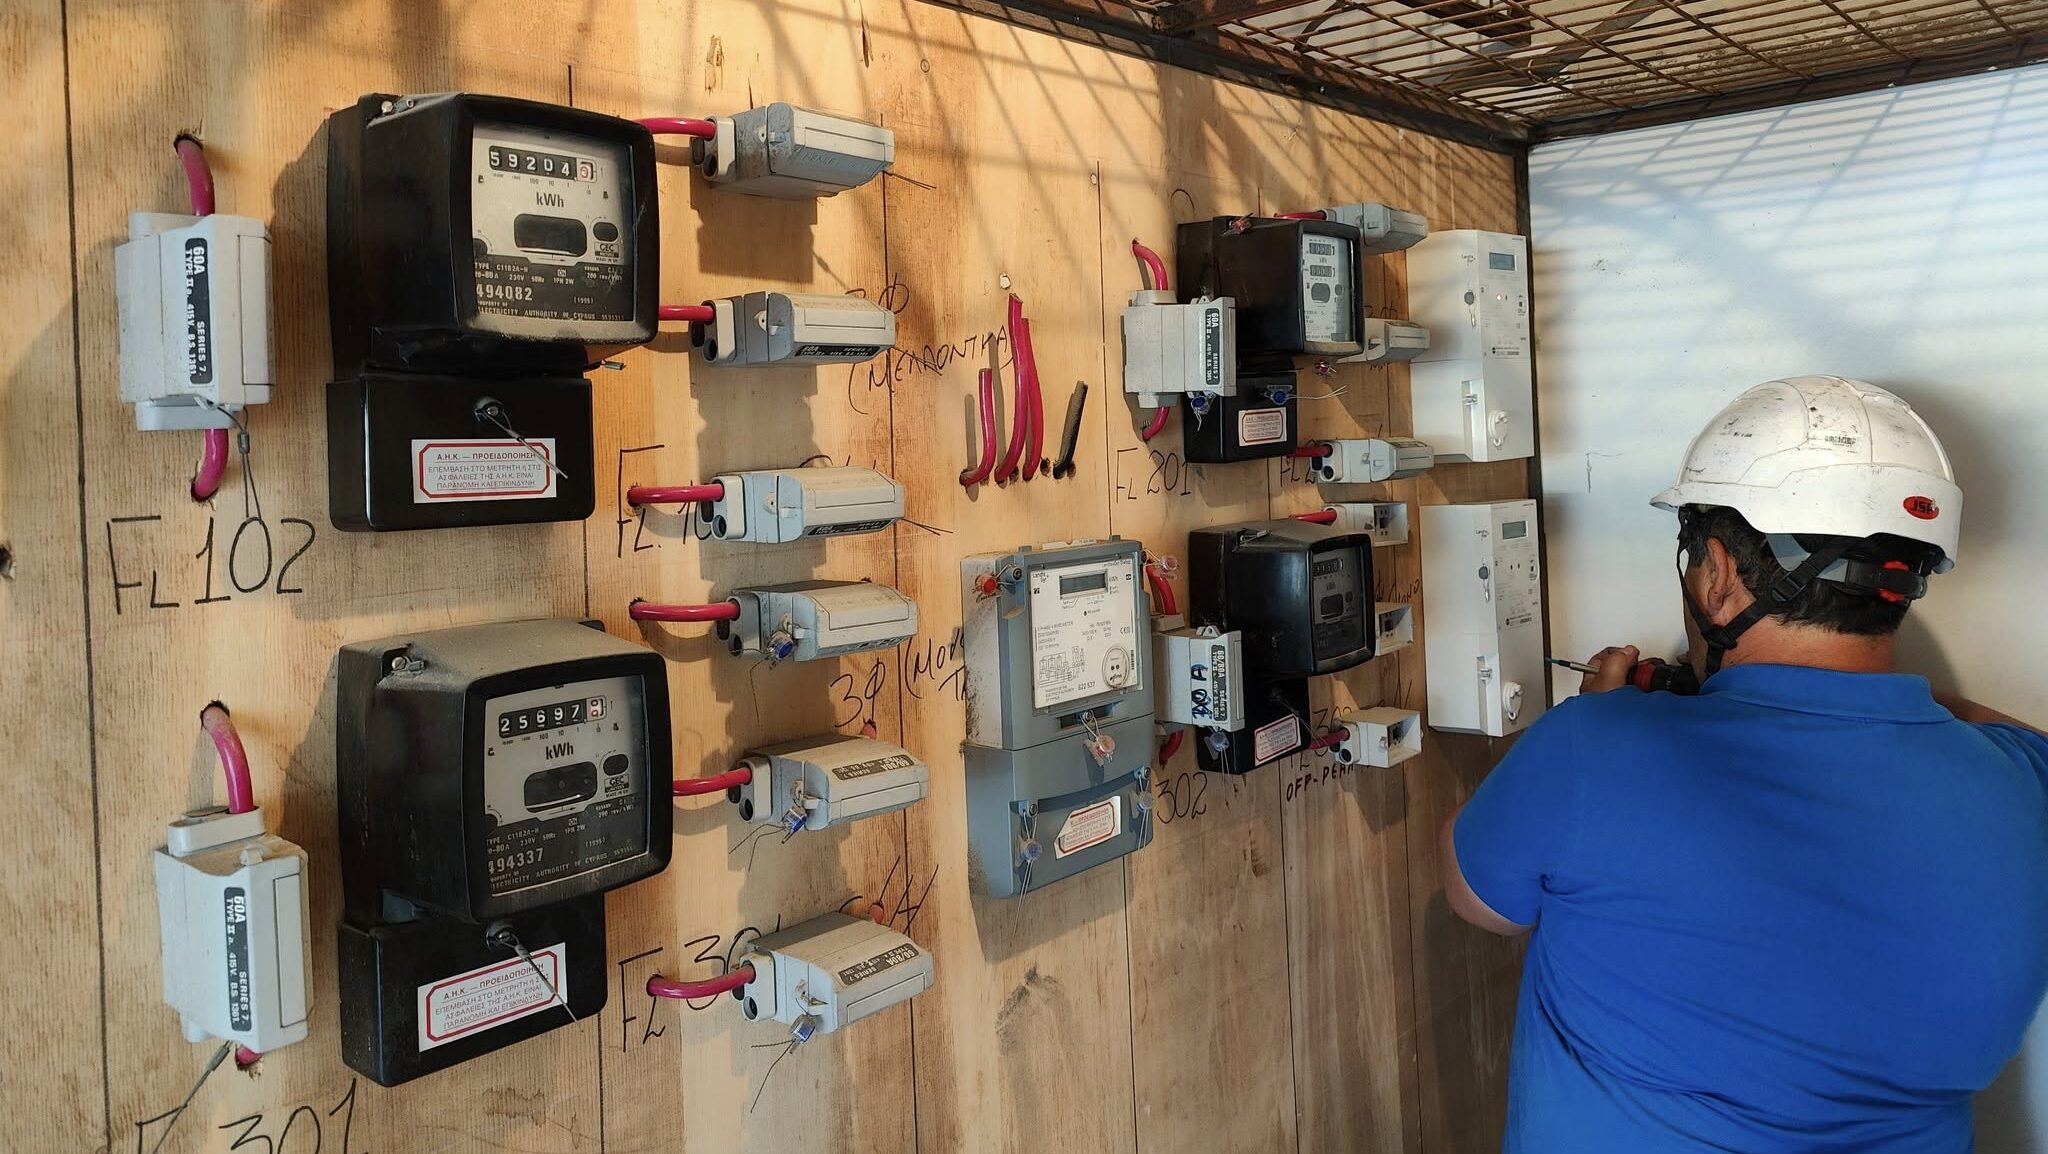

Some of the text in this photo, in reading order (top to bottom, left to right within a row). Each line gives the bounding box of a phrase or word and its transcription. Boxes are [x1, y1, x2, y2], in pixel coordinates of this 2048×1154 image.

[536, 192, 564, 208] kWh
[193, 246, 206, 275] 60A
[476, 283, 533, 301] 494082
[1211, 312, 1219, 328] 60A
[197, 321, 207, 362] SERIES
[428, 465, 469, 474] ΕΠΕΜΒΑΣΗ
[471, 464, 485, 472] ΣΤΟ
[487, 464, 522, 472] ΜΕΤΡΗΤΗ
[527, 463, 542, 471] ΣΤΙΣ
[472, 452, 537, 460] ΠΡΟΕΙΔΟΠΟΙΗΣΗ
[437, 481, 479, 490] ΠΑΡΑΝΟΜΗ
[480, 472, 494, 480] ΤΗΣ
[516, 471, 534, 479] ΕΙΝΑΙ
[1146, 449, 1192, 497] 201
[194, 516, 316, 605] 102
[545, 742, 574, 761] kWh
[1156, 771, 1208, 824] 302
[488, 847, 544, 875] 494337
[535, 862, 569, 878] AUTHORITY
[226, 897, 235, 923] TYPE
[234, 895, 246, 923] 60A
[885, 949, 915, 966] 60/80A
[239, 971, 249, 1010] SERIES
[435, 997, 477, 1016] ΕΠΕΜΒΑΣΗ
[477, 991, 492, 1002] ΣΤΟ
[494, 980, 529, 996] ΜΕΤΡΗΤΗ
[445, 1004, 486, 1020] ΑΣΦΑΛΕΙΕΣ
[487, 998, 501, 1009] ΤΗΣ
[524, 984, 542, 996] ΕΙΝΑΙ
[443, 992, 543, 1030] ΠΑΡΑΝΟΜΗ ΚΑΙ ΕΠΙΚΙΝΔΥΝΗ
